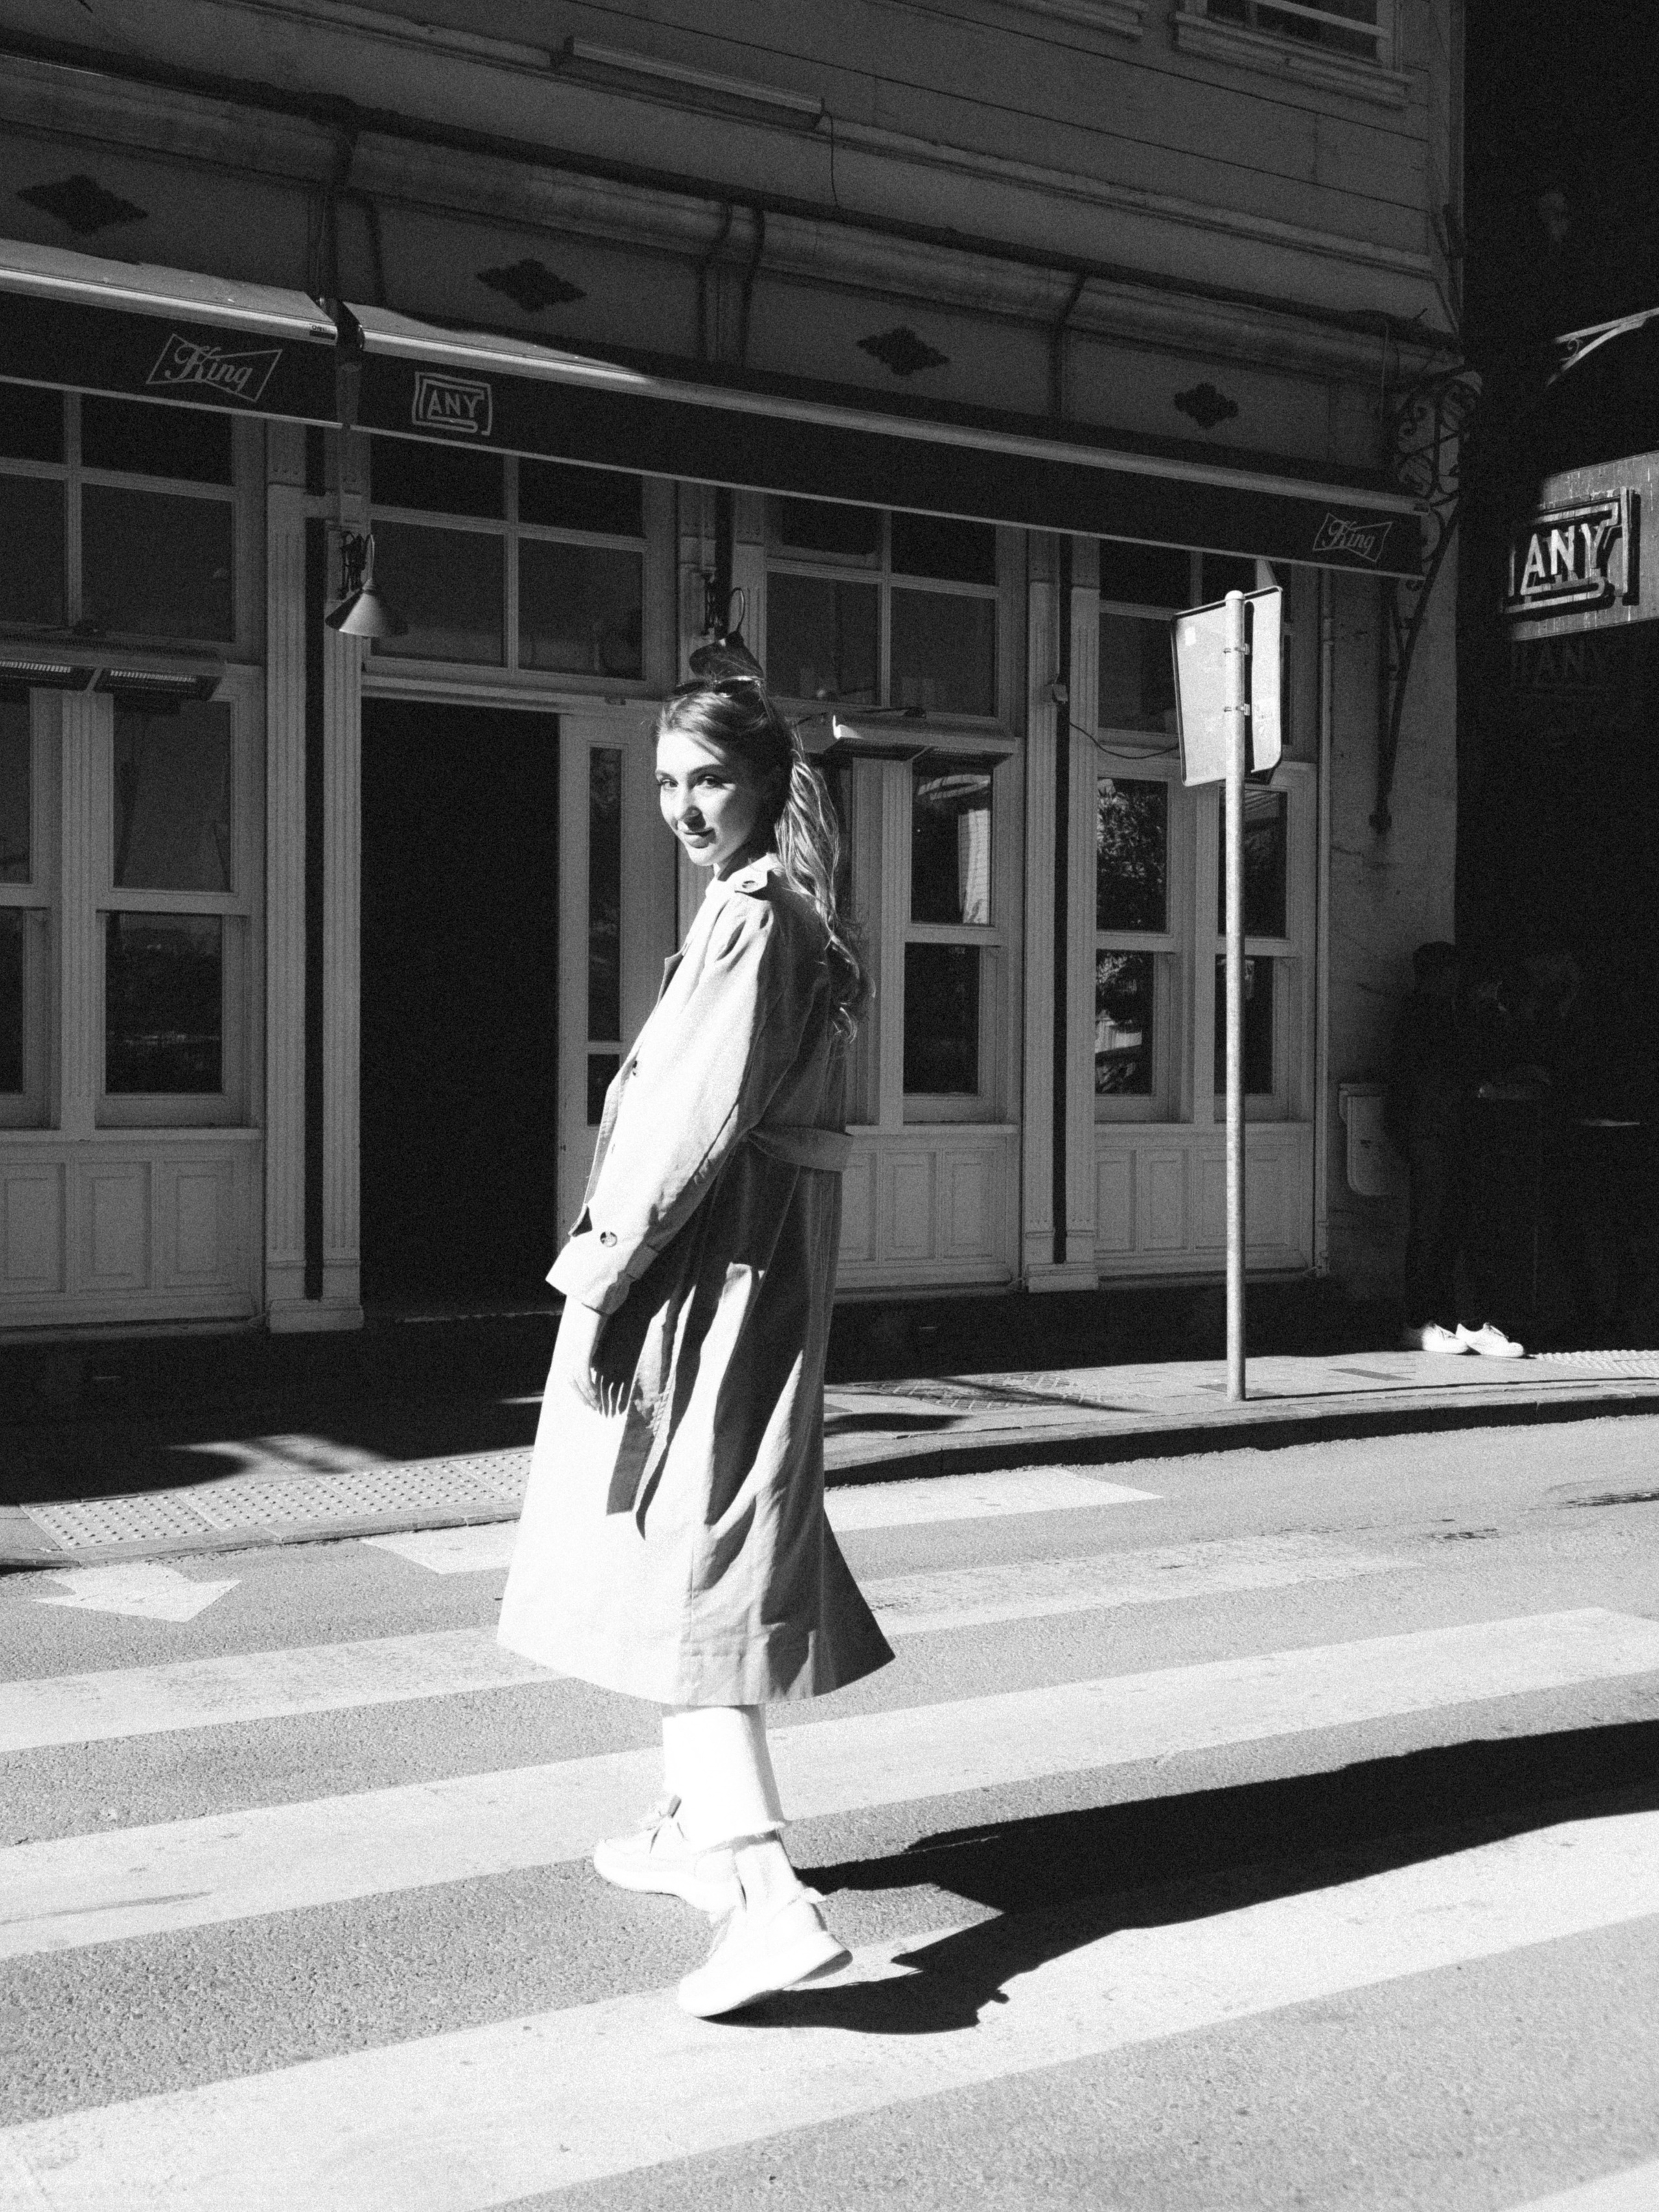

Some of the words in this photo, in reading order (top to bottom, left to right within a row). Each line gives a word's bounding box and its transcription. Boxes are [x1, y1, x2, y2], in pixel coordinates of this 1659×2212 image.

[165, 345, 253, 393] King
[426, 390, 481, 419] ANY
[1322, 520, 1375, 556] King
[1520, 522, 1610, 595] ANY
